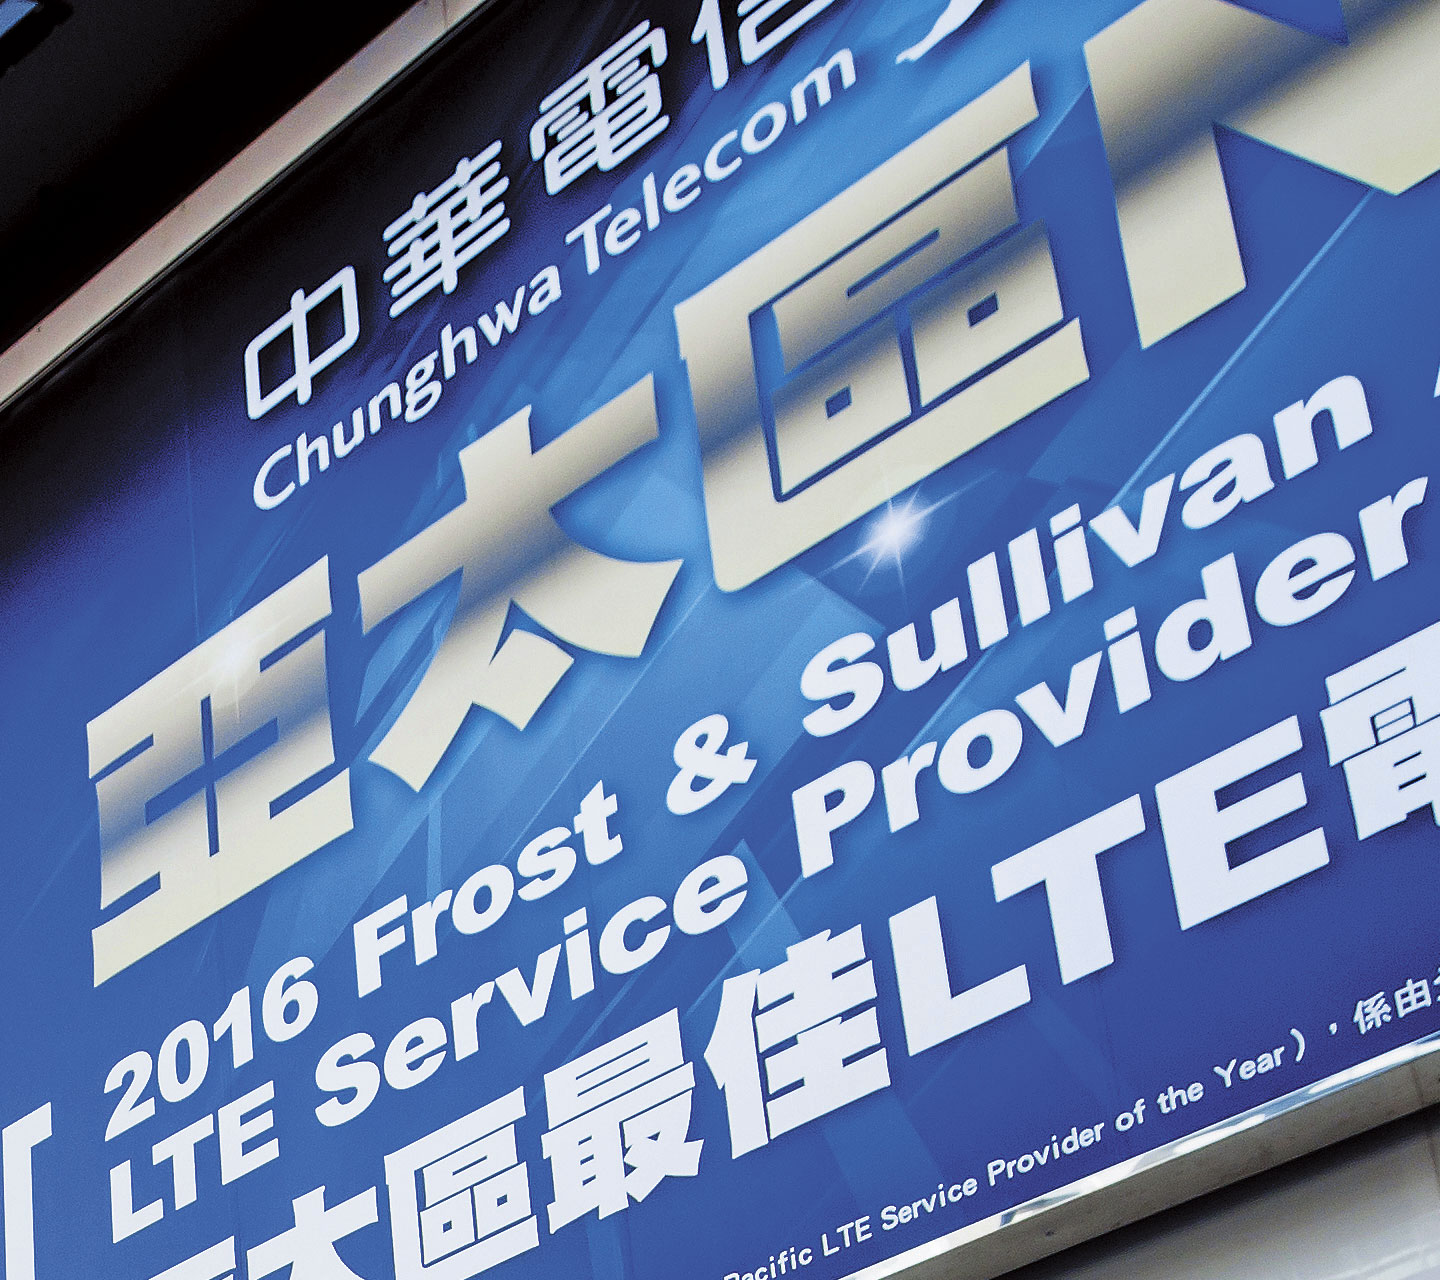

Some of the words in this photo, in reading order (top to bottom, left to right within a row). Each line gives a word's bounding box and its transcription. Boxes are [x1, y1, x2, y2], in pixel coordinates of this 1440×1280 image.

[252, 268, 563, 514] Chunghwa
[566, 44, 859, 275] Telecom
[103, 956, 319, 1143] 2016
[350, 784, 623, 998] Frost
[663, 711, 759, 815] &
[800, 373, 1375, 740] Sullivan
[109, 1080, 280, 1245] LTE
[313, 853, 750, 1128] Service
[791, 471, 1431, 882] Provider
[821, 1216, 873, 1258] LTE
[879, 1174, 979, 1232] Service
[987, 1119, 1105, 1188] Provider
[1114, 1097, 1148, 1134] of
[1155, 1078, 1206, 1117] the
